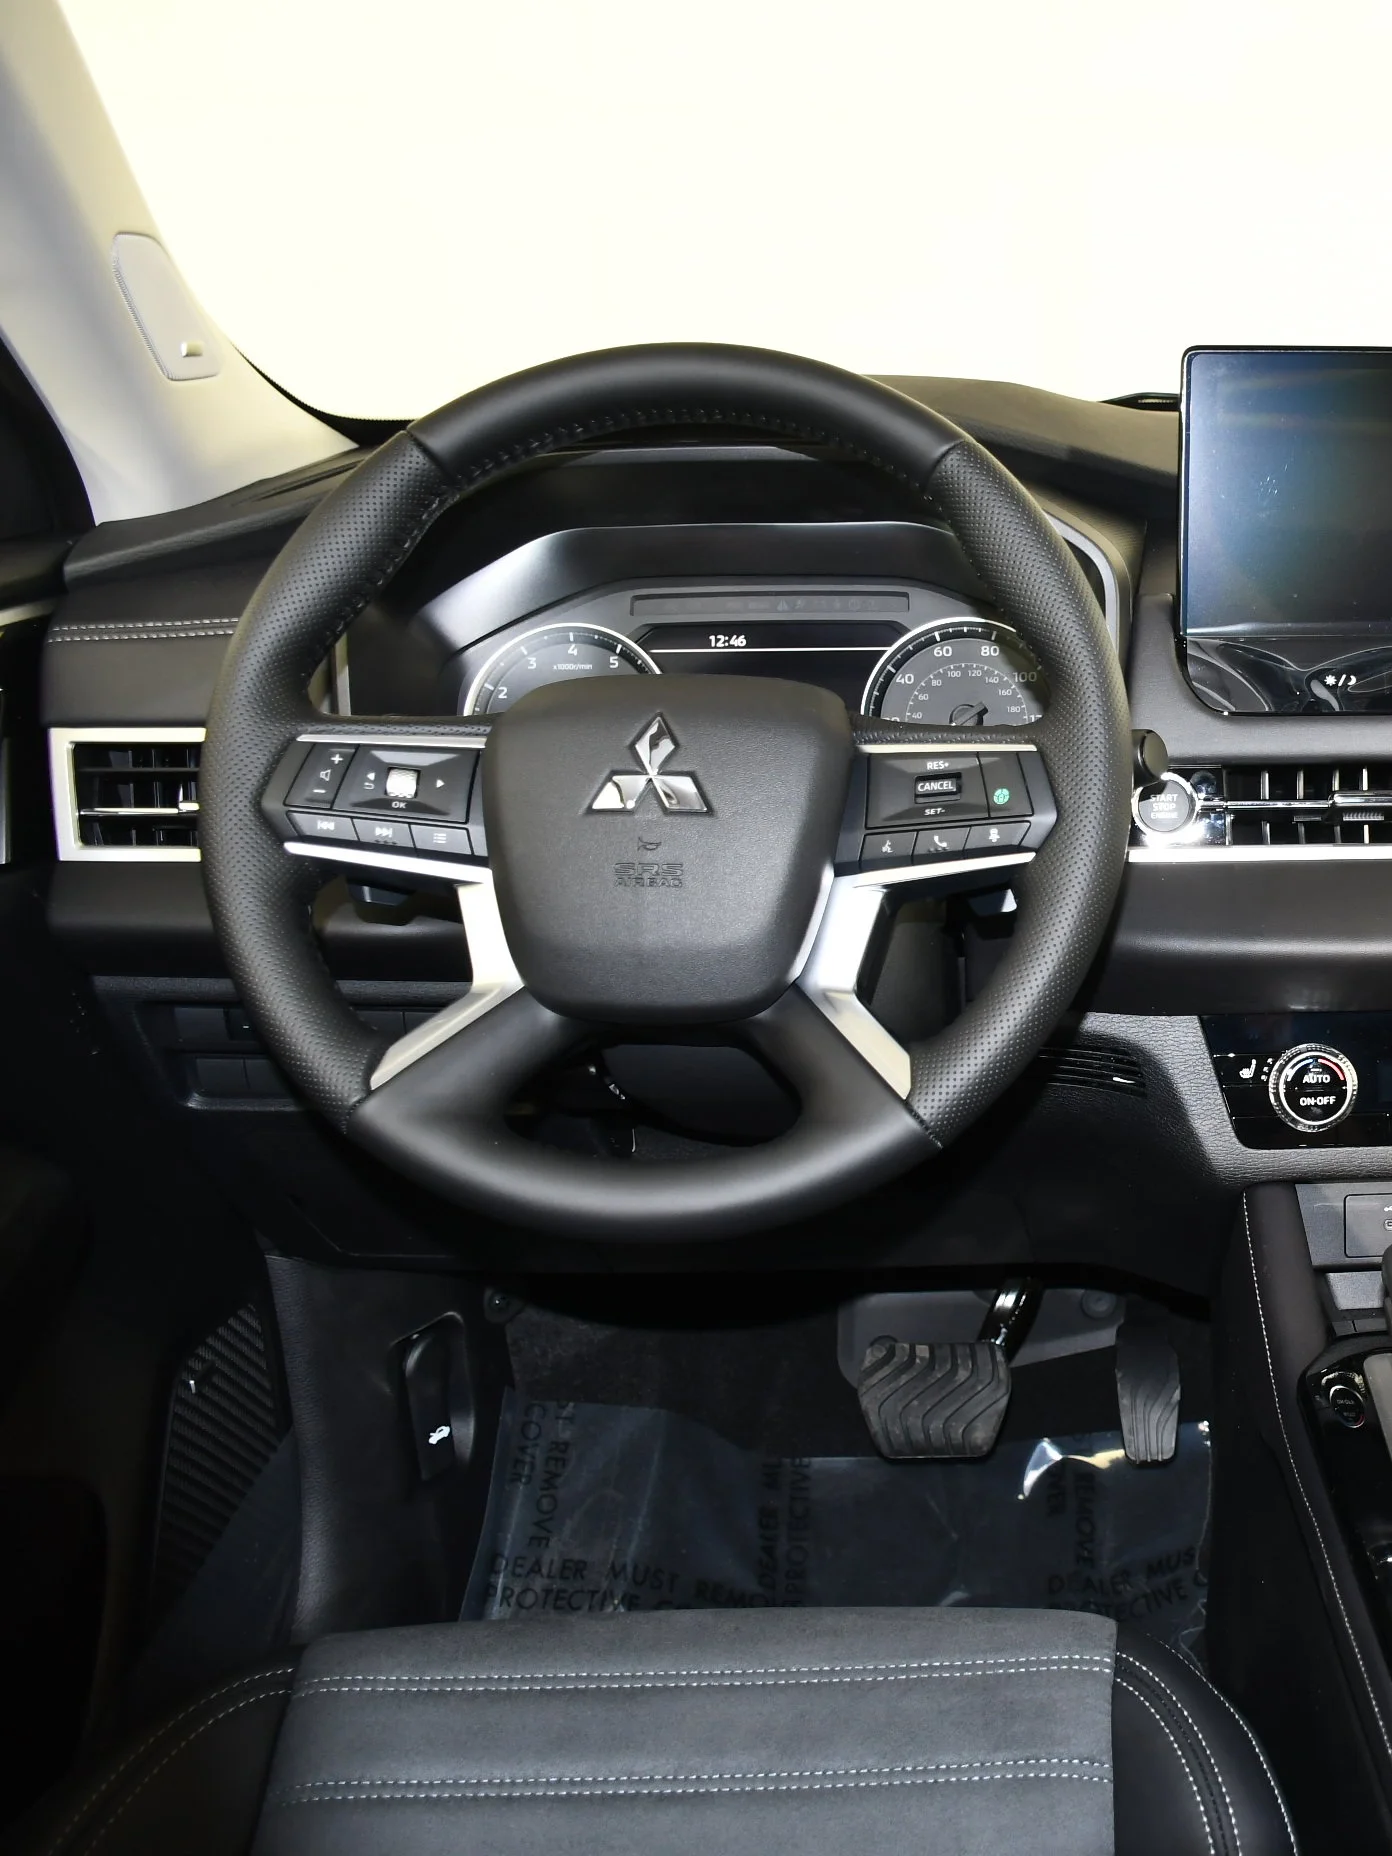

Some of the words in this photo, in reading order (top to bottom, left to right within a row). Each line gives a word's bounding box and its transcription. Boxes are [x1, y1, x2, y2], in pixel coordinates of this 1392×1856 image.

[709, 635, 747, 647] 12:46
[567, 643, 578, 656] 4
[933, 646, 952, 657] 60
[980, 645, 1000, 657] 80
[527, 657, 537, 669] 3
[609, 656, 619, 668] 5
[947, 670, 962, 678] 100
[967, 669, 982, 677] 120
[1013, 671, 1038, 683] 100
[896, 673, 914, 685] 40
[931, 679, 942, 687] 80
[985, 675, 999, 684] 140
[498, 687, 508, 699] 2
[918, 693, 929, 701] 60
[911, 711, 923, 720] 40
[926, 761, 949, 770] RES+
[917, 781, 955, 792] CANCEL
[1150, 793, 1178, 802] START
[391, 801, 407, 809] OK
[1152, 802, 1176, 812] STOP
[924, 807, 946, 815] SET-
[613, 862, 684, 876] SRS
[613, 876, 684, 888] AIRBAG
[1302, 1074, 1331, 1084] AUTO
[509, 1402, 548, 1487] COVER
[528, 1439, 571, 1549] REMOVE
[786, 1456, 812, 1596] PROTECTIVE
[490, 1553, 588, 1582] DEALER
[605, 1561, 680, 1593] MUST
